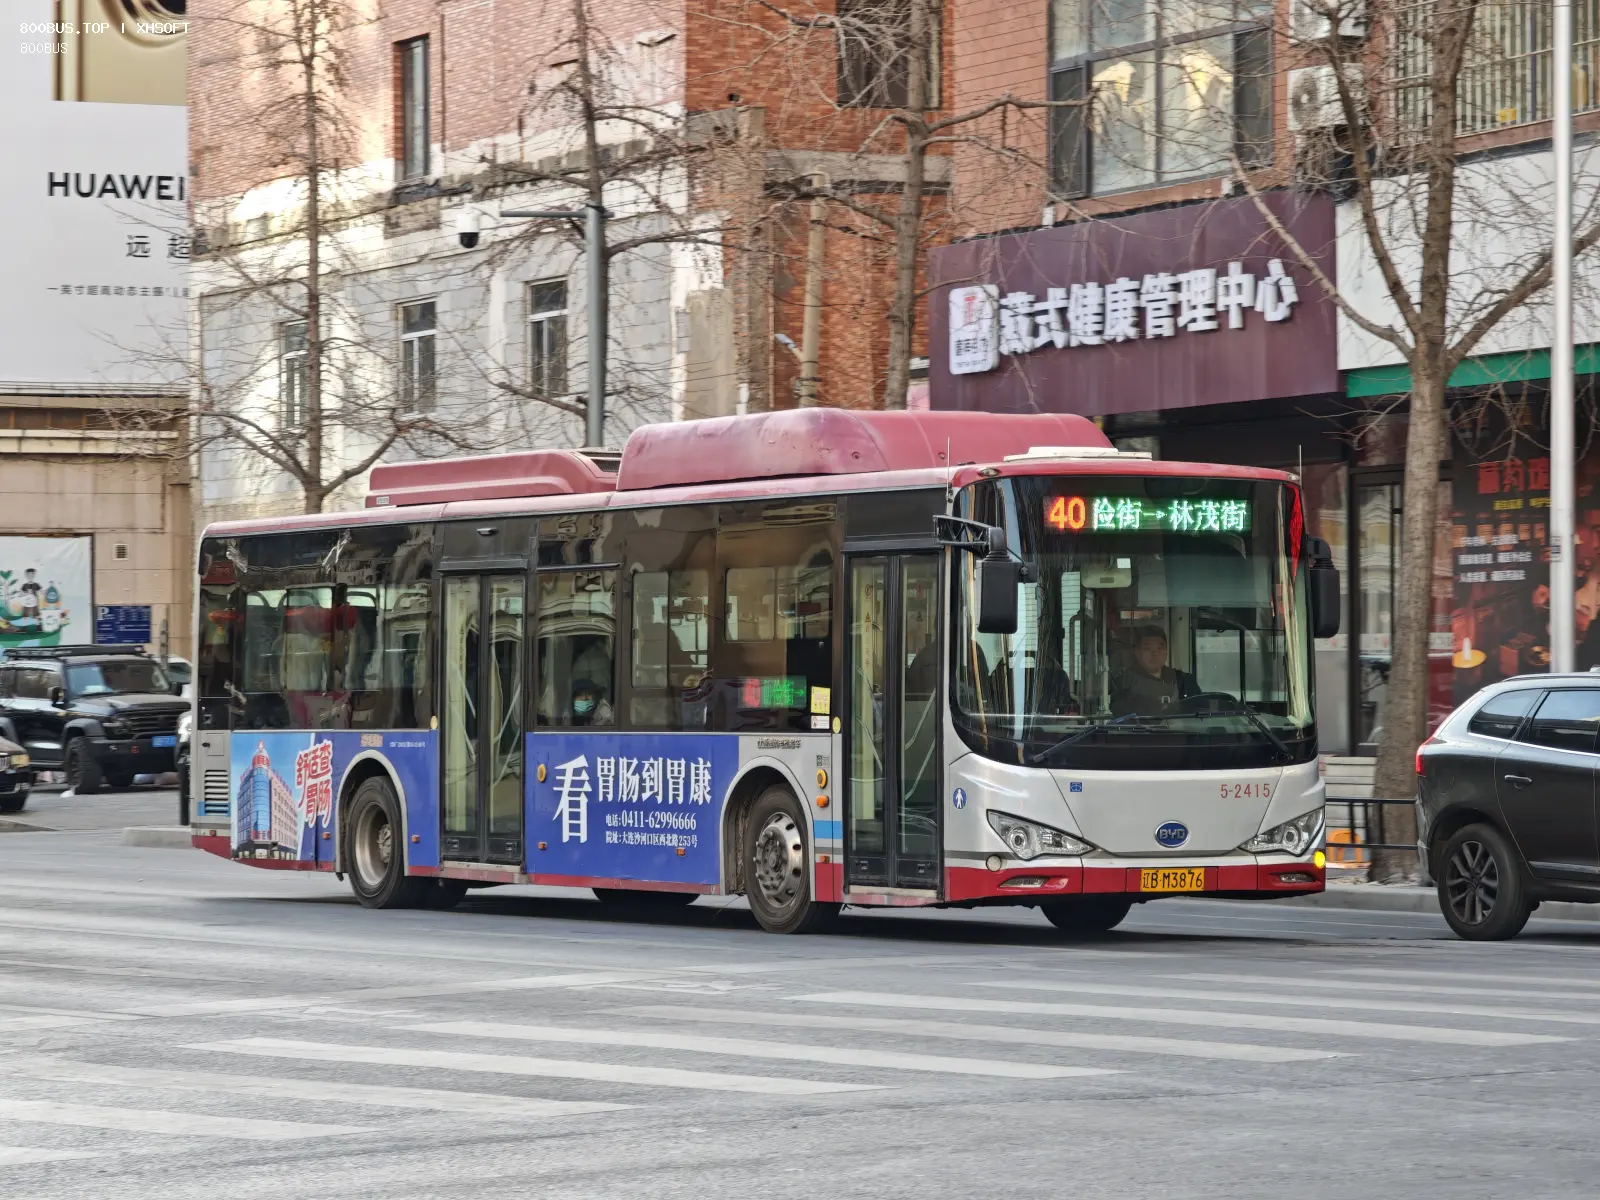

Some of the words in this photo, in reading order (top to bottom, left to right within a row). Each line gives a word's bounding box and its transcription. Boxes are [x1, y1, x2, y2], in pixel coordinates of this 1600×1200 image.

[47, 172, 186, 200] HUAWEI
[1049, 497, 1086, 529] 40
[1168, 499, 1247, 532] 林茂街
[96, 607, 109, 620] P
[306, 779, 331, 826] 胃肠
[552, 754, 592, 843] 看
[597, 756, 712, 805] 胃肠到胃康
[1221, 784, 1271, 798] 5-2415
[1159, 829, 1186, 840] BYD
